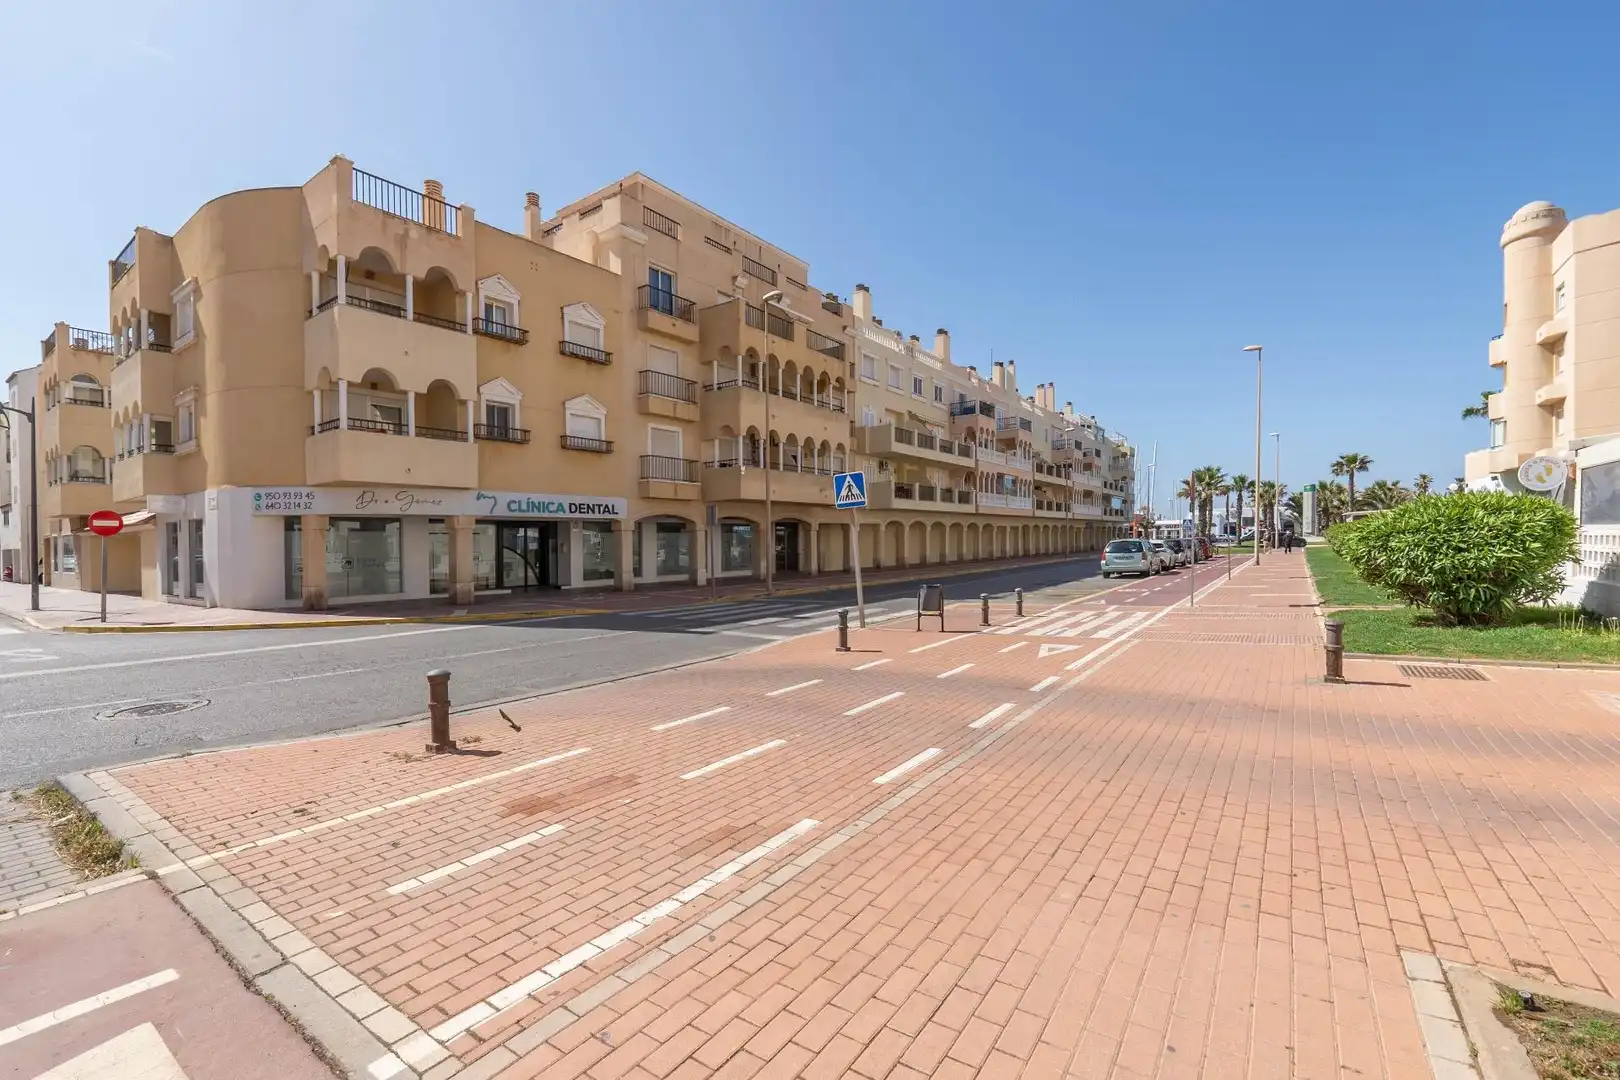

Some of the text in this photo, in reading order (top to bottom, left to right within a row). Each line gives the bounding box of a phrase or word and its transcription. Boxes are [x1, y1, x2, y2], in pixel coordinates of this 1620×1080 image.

[264, 492, 315, 500] 950 93 93 45
[265, 501, 312, 510] 640 32 14 32
[506, 497, 619, 515] CLÍNICA DENTAL
